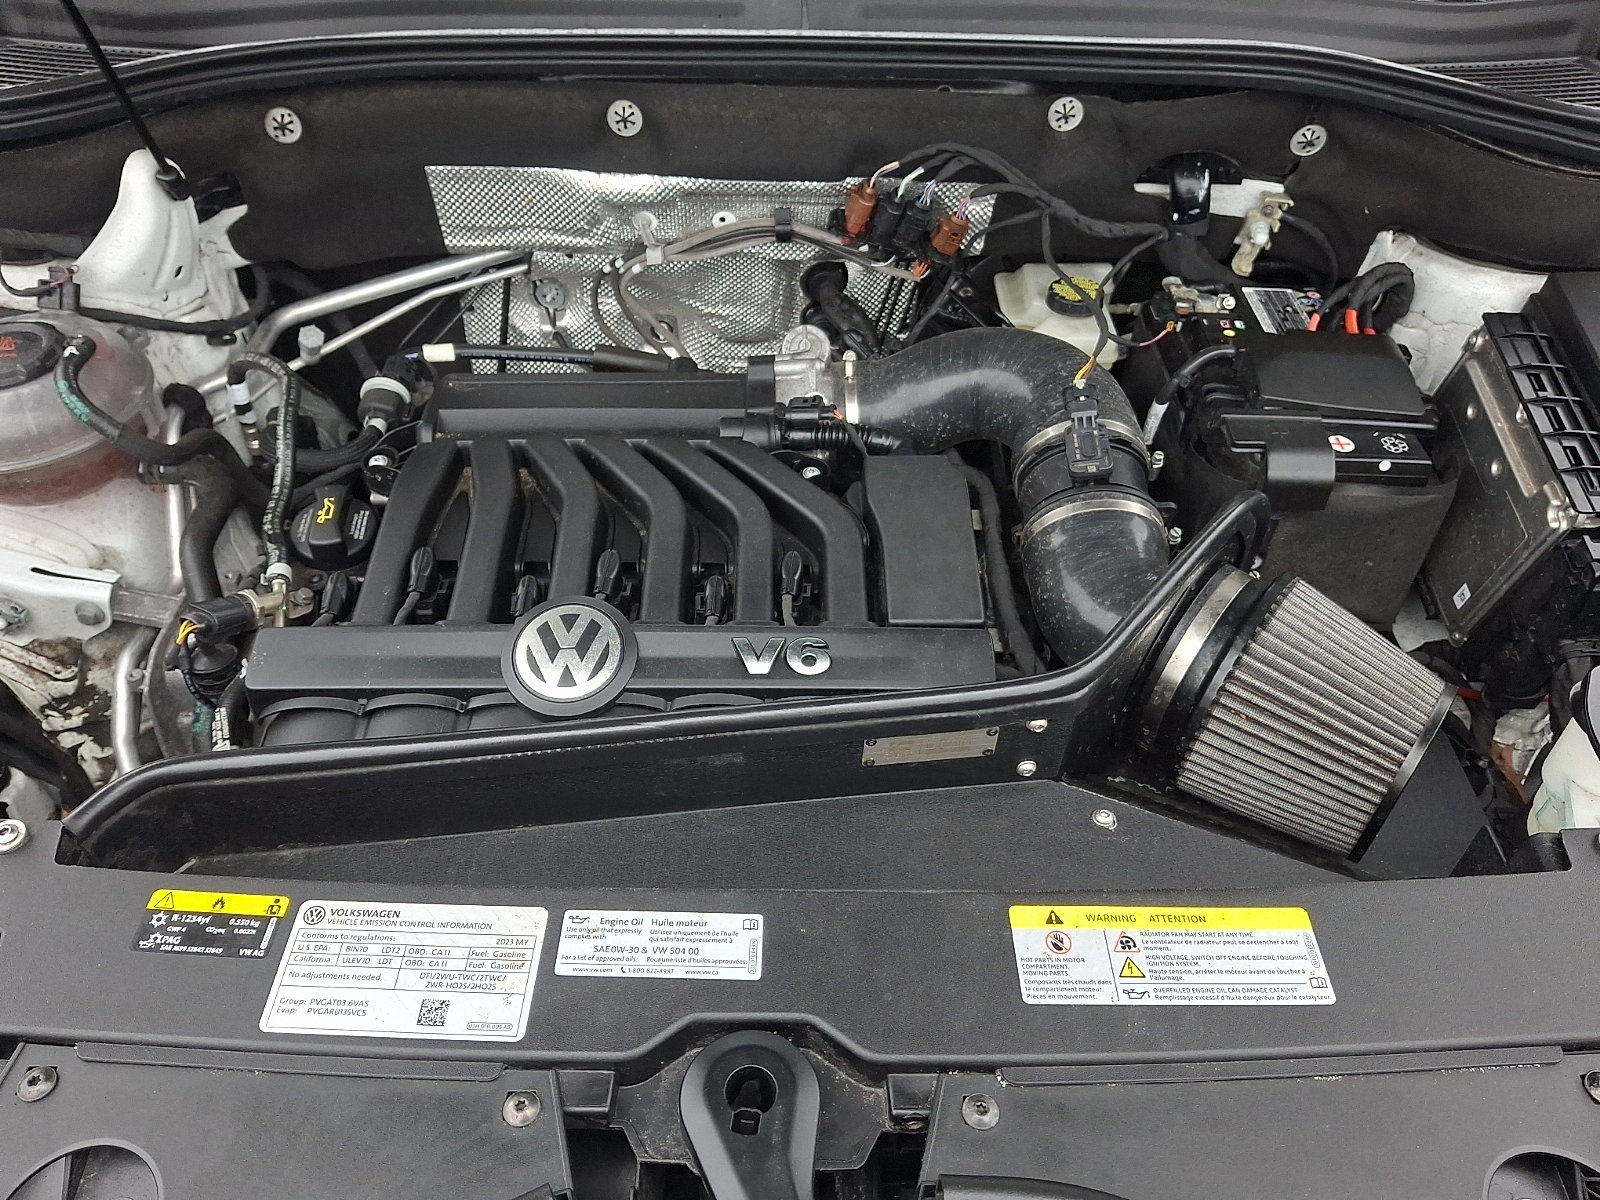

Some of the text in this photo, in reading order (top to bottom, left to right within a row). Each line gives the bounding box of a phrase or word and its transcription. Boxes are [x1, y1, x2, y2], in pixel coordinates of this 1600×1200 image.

[731, 636, 833, 676] V6
[330, 908, 400, 918] VOLKSWAGEN
[600, 918, 629, 927] Engine
[1086, 914, 1206, 922] WARNING ATTENTION
[360, 919, 398, 927] EMISSION
[437, 921, 492, 930] INFORMATION
[160, 936, 182, 945] PAG
[302, 932, 338, 940] Conforms
[350, 932, 396, 942] regulations:
[253, 949, 264, 957] AG
[493, 950, 526, 958] Gasoline
[491, 962, 524, 970] Gasoline
[301, 972, 350, 980] adjustments
[280, 997, 306, 1006] Group:
[277, 1006, 298, 1015] Evap:
